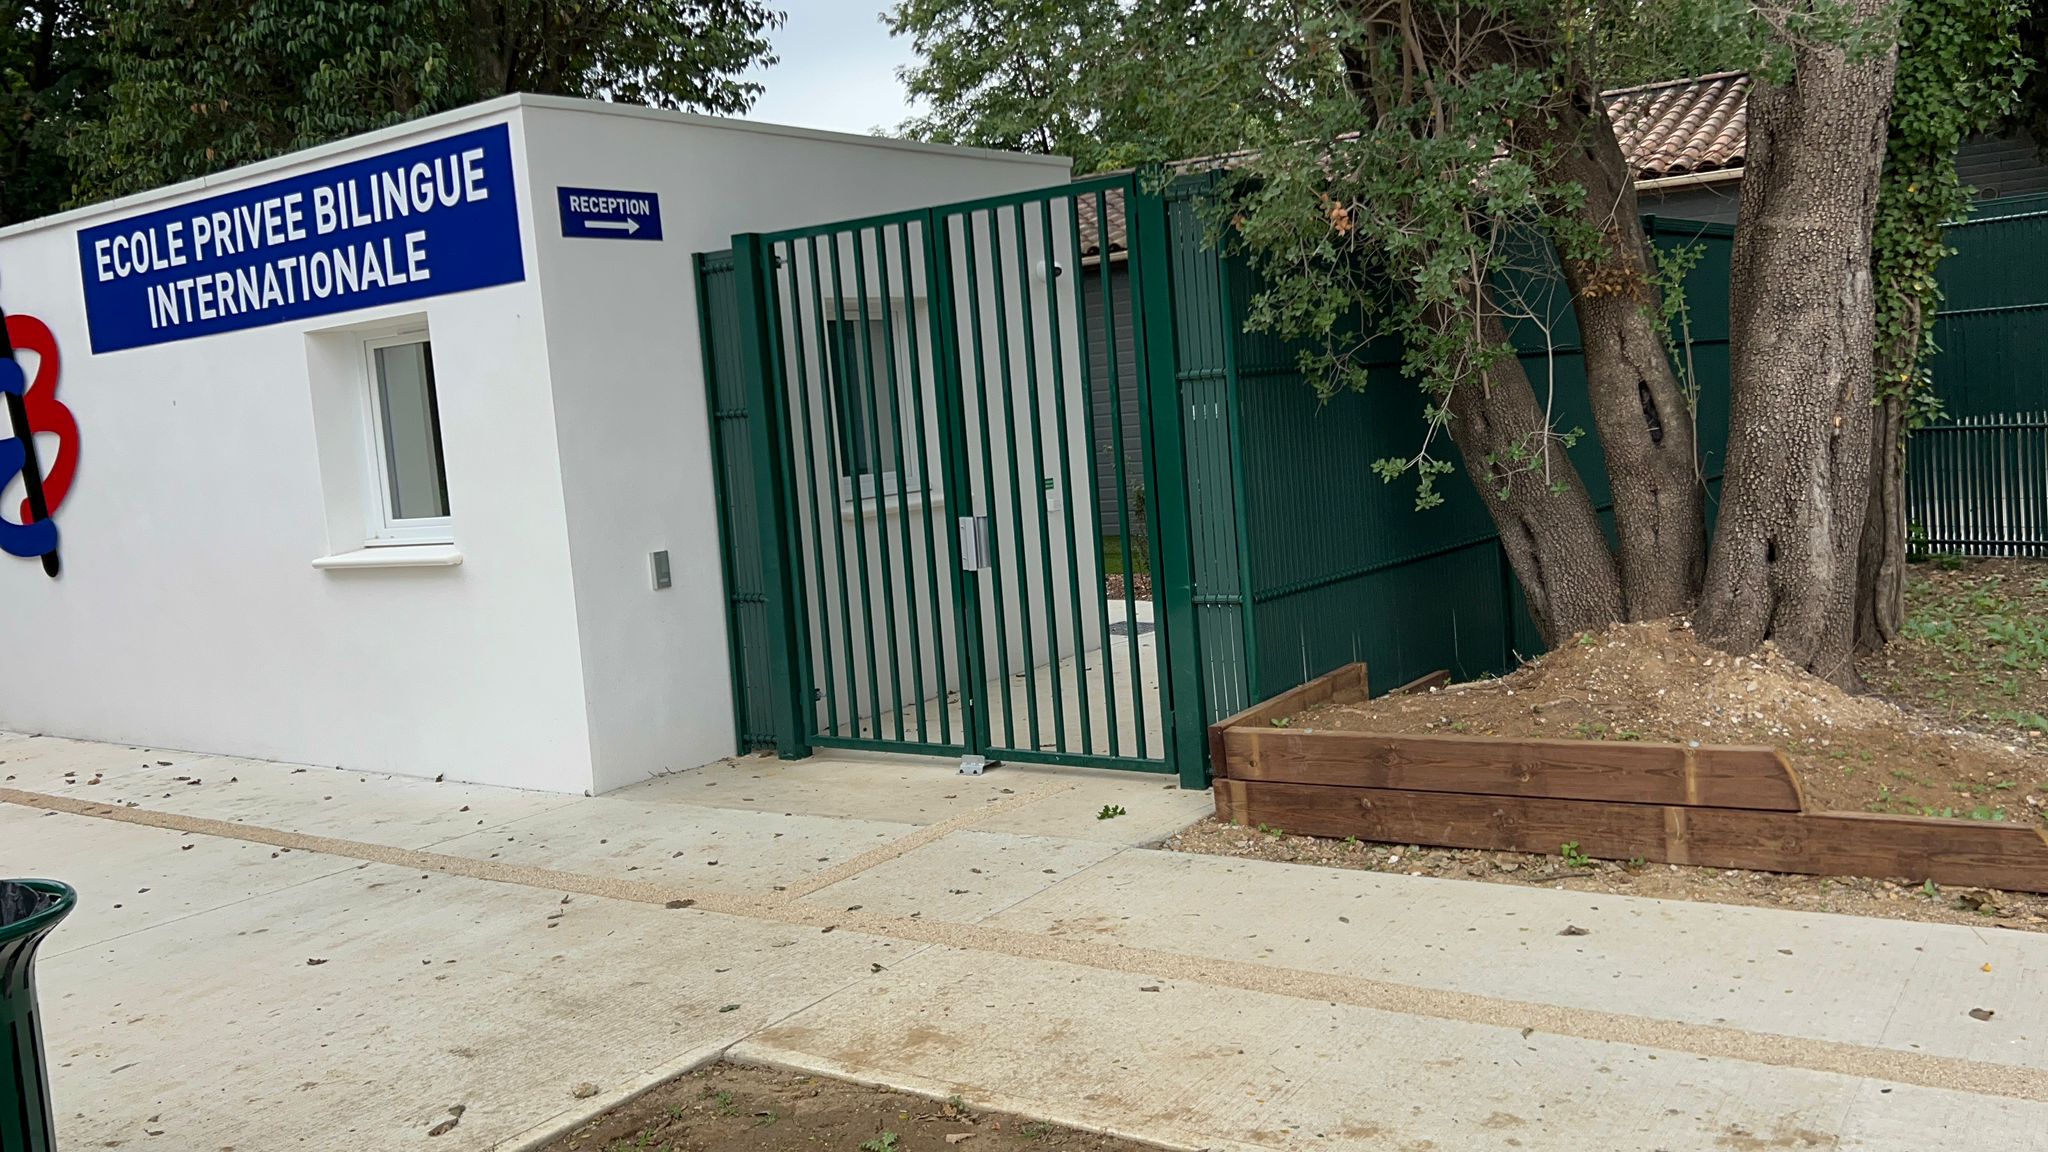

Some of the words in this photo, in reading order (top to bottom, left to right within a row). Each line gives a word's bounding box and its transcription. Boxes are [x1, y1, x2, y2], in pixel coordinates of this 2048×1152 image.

[94, 221, 187, 282] ECOLE
[191, 192, 307, 261] PRIVEE
[313, 147, 488, 235] BILINGUE
[569, 195, 651, 215] RECEPTION
[147, 230, 430, 329] INTERNATIONALE
